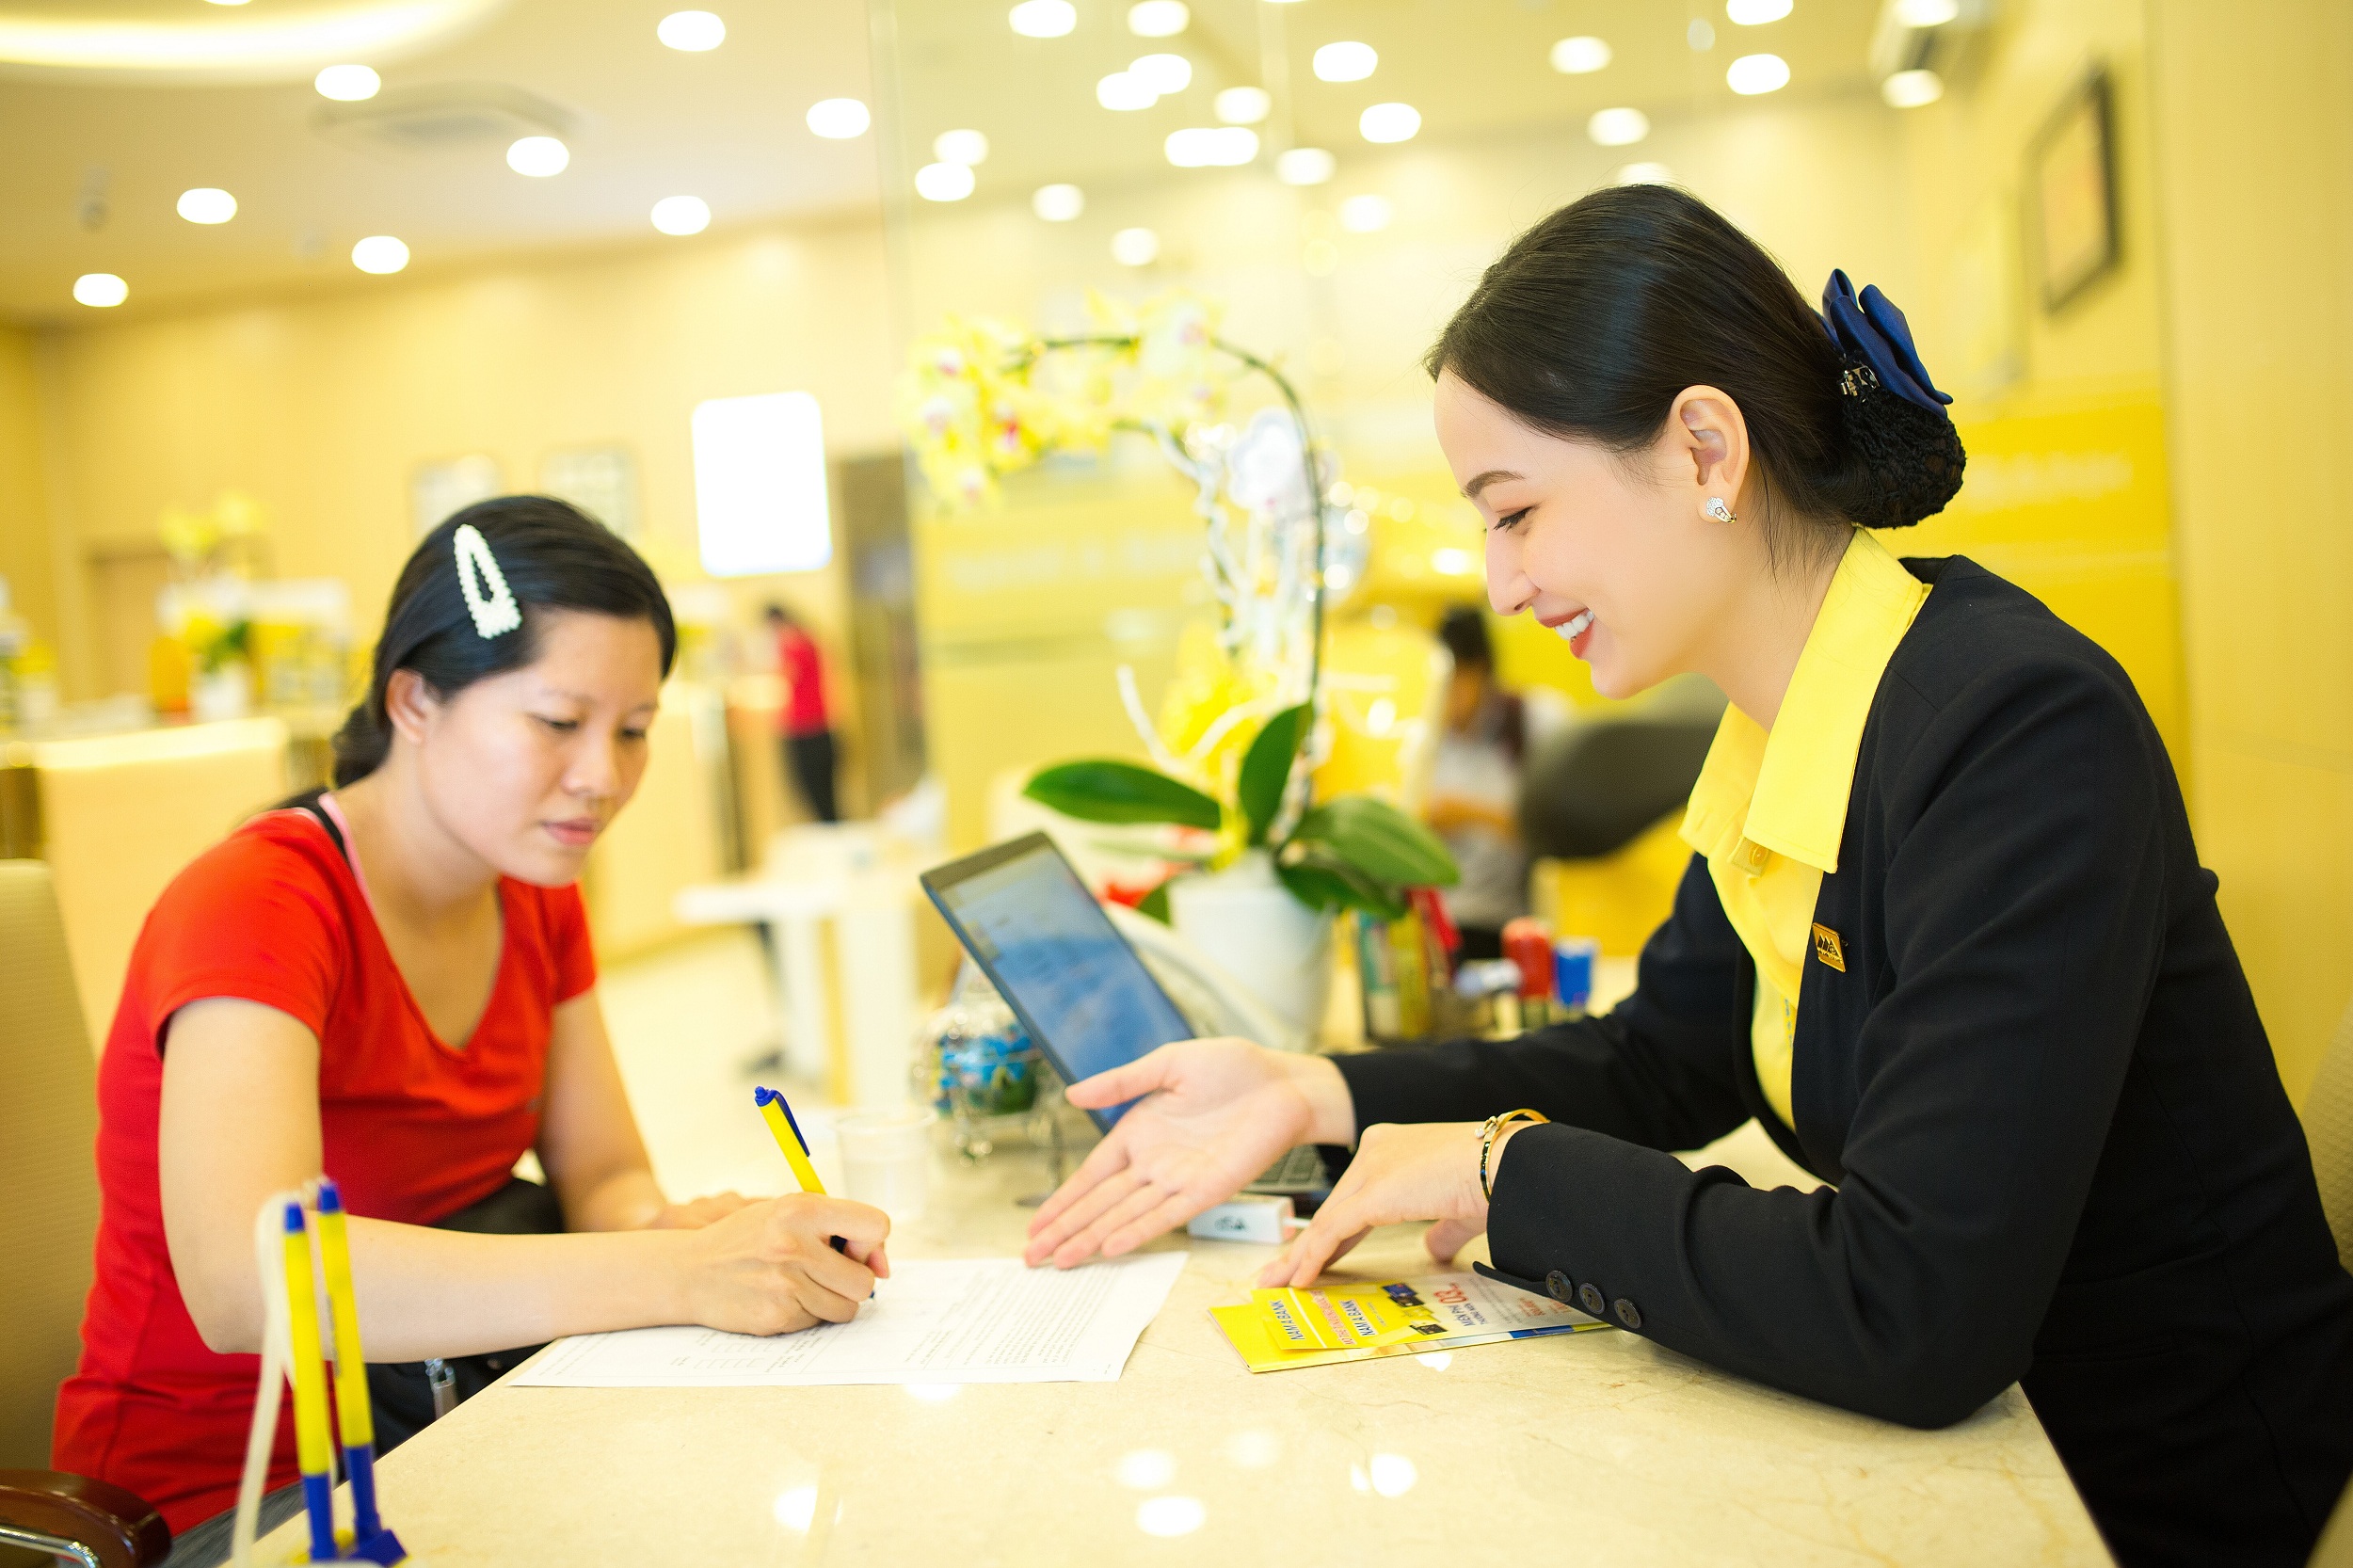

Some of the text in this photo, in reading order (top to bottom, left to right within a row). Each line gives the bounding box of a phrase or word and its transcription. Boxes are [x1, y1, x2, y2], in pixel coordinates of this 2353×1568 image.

[1270, 1300, 1290, 1320] BANK
[1338, 1299, 1362, 1316] BANK
[1283, 1324, 1305, 1340] NAM
[1354, 1321, 1375, 1336] NAM
